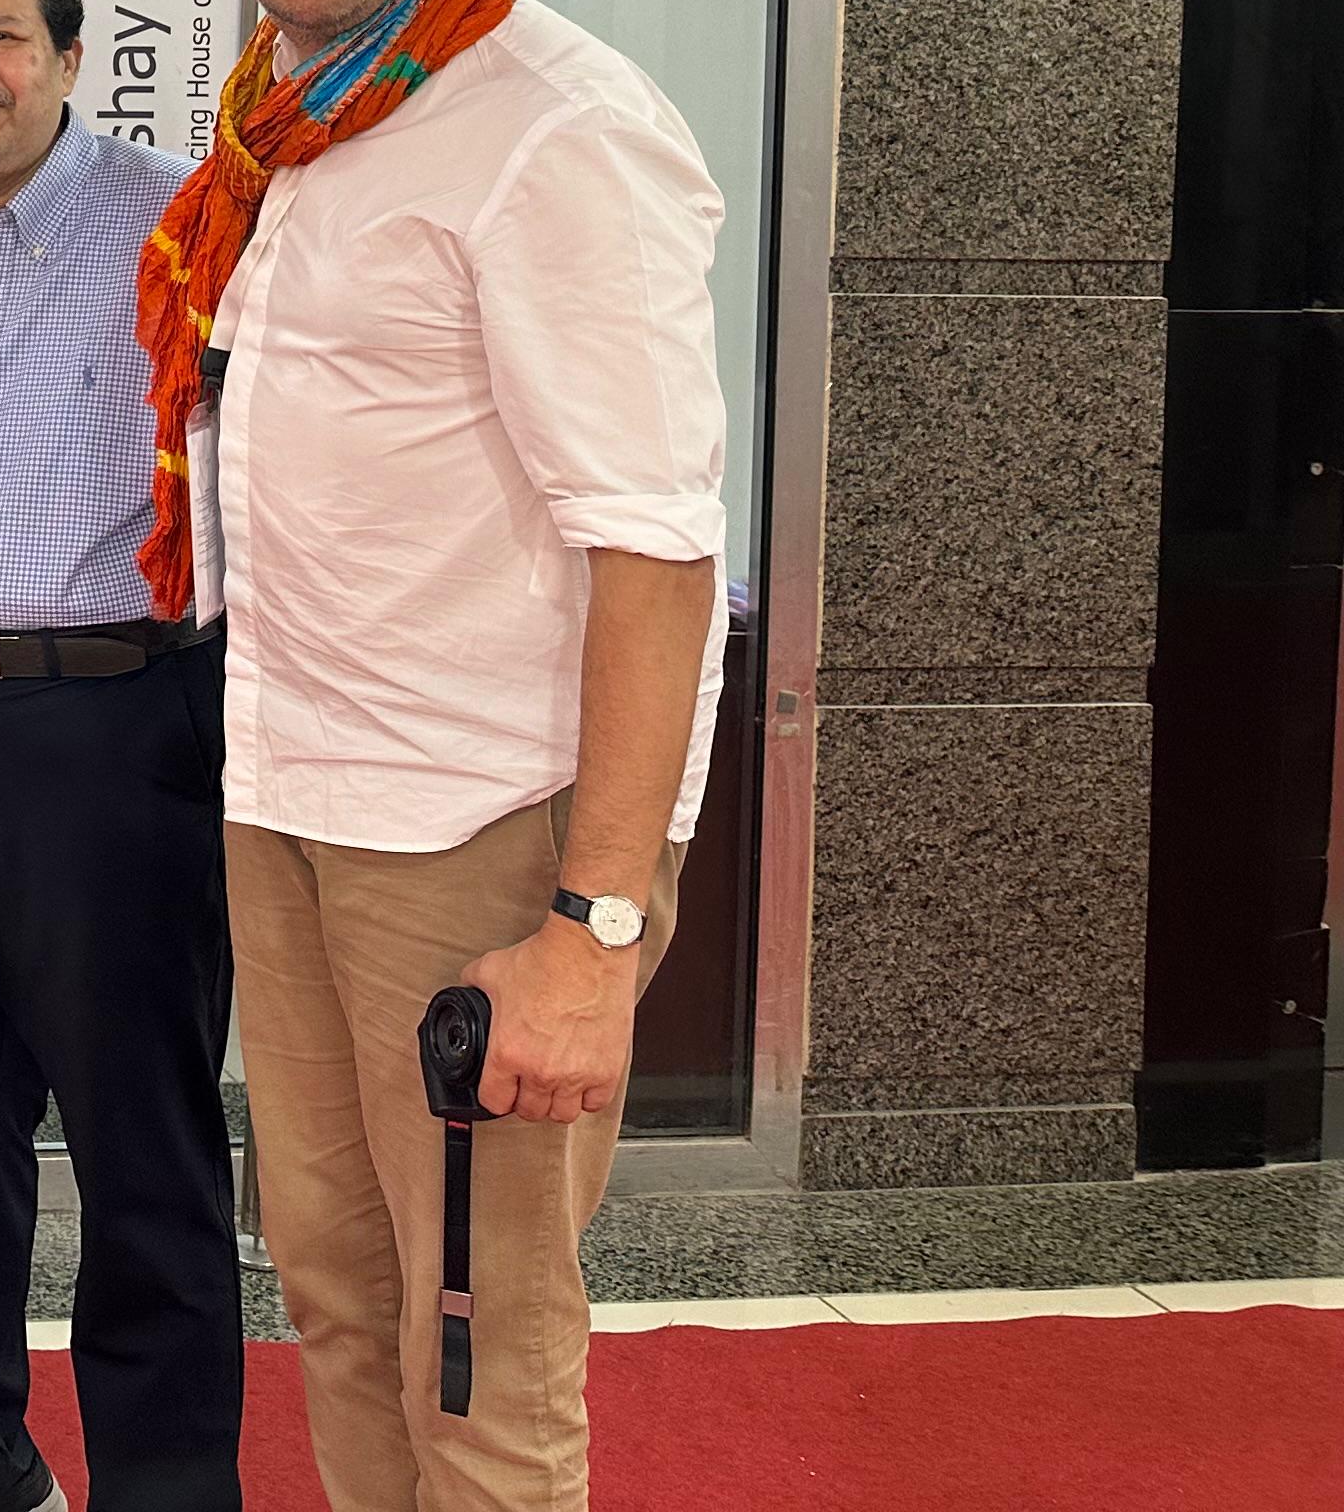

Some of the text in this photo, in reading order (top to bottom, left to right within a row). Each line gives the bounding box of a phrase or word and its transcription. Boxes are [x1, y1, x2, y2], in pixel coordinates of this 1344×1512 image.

[97, 4, 172, 148] shay
[186, 17, 211, 98] House
[185, 109, 214, 161] cing
